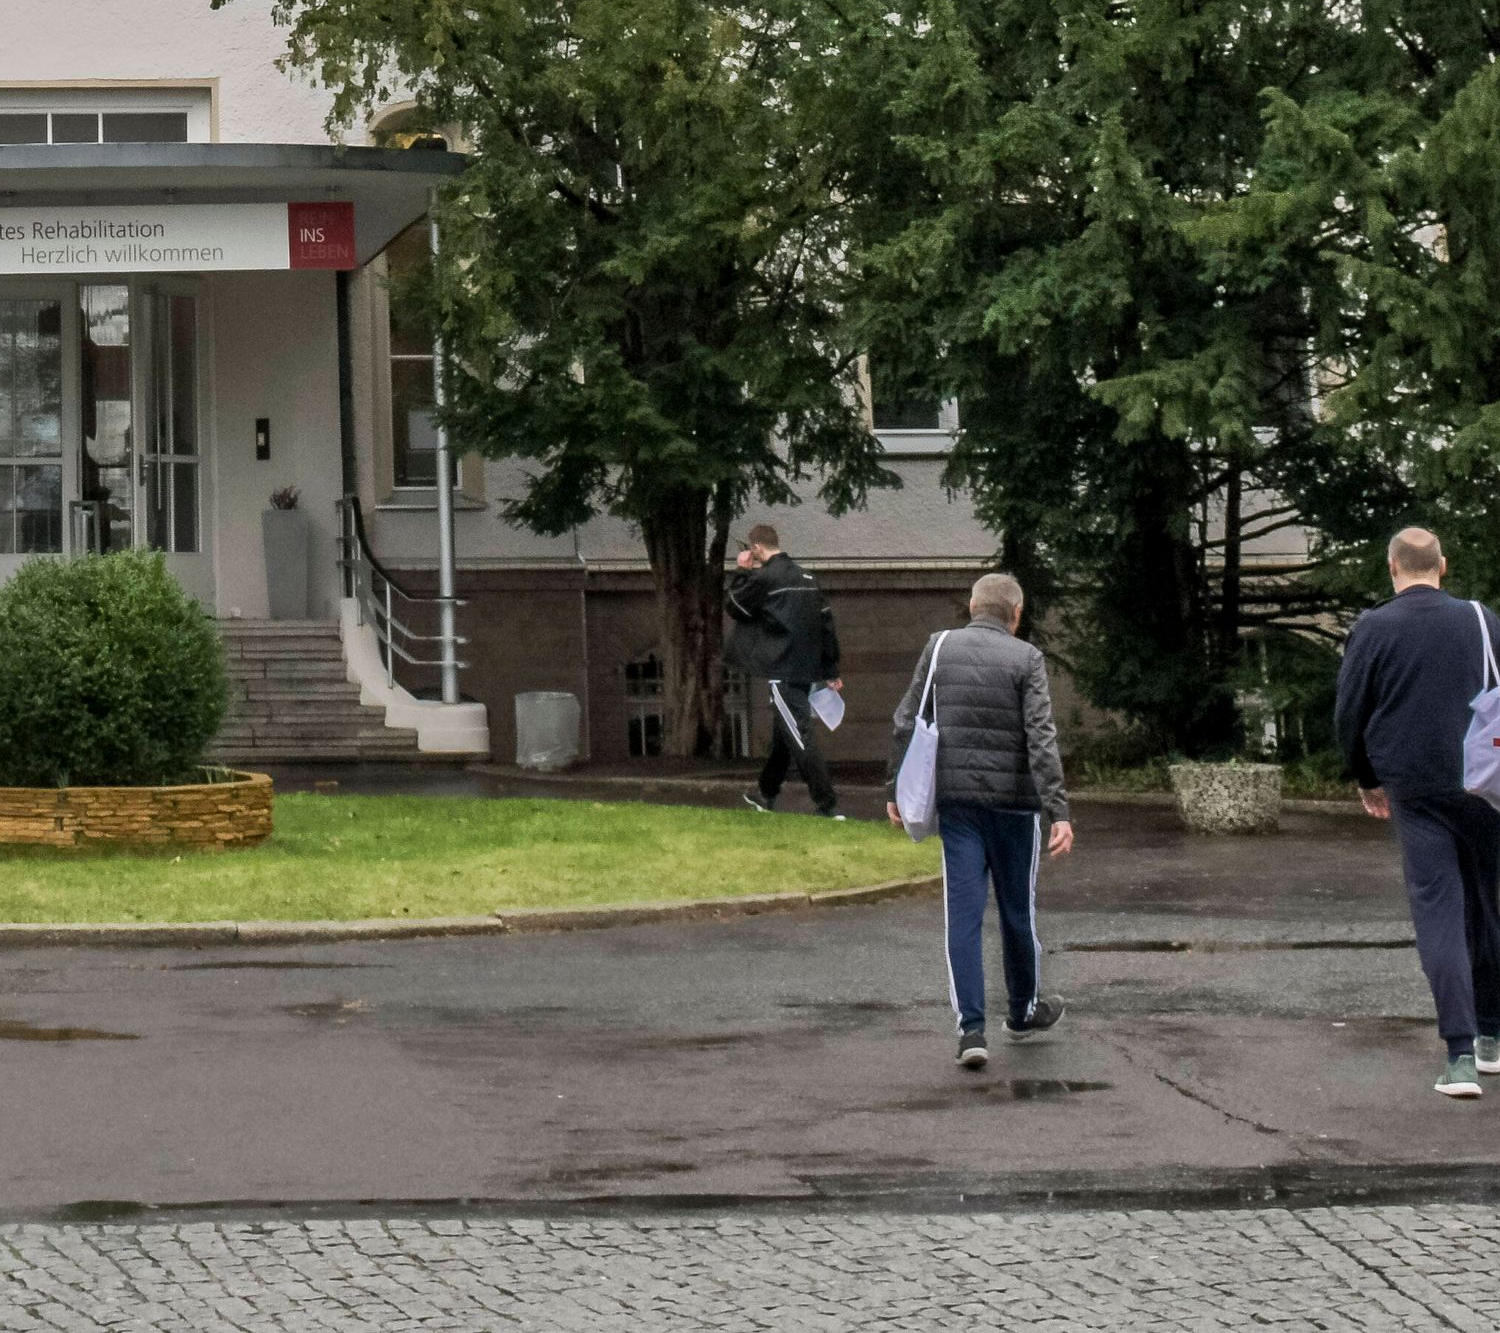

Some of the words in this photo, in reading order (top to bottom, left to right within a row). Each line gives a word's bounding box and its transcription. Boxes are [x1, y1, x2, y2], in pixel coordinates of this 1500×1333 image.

[32, 220, 164, 239] Rehabilitation
[300, 228, 325, 243] INS
[21, 243, 97, 265] Herzlich
[105, 242, 224, 263] willkommen
[301, 244, 348, 259] LEBEN
